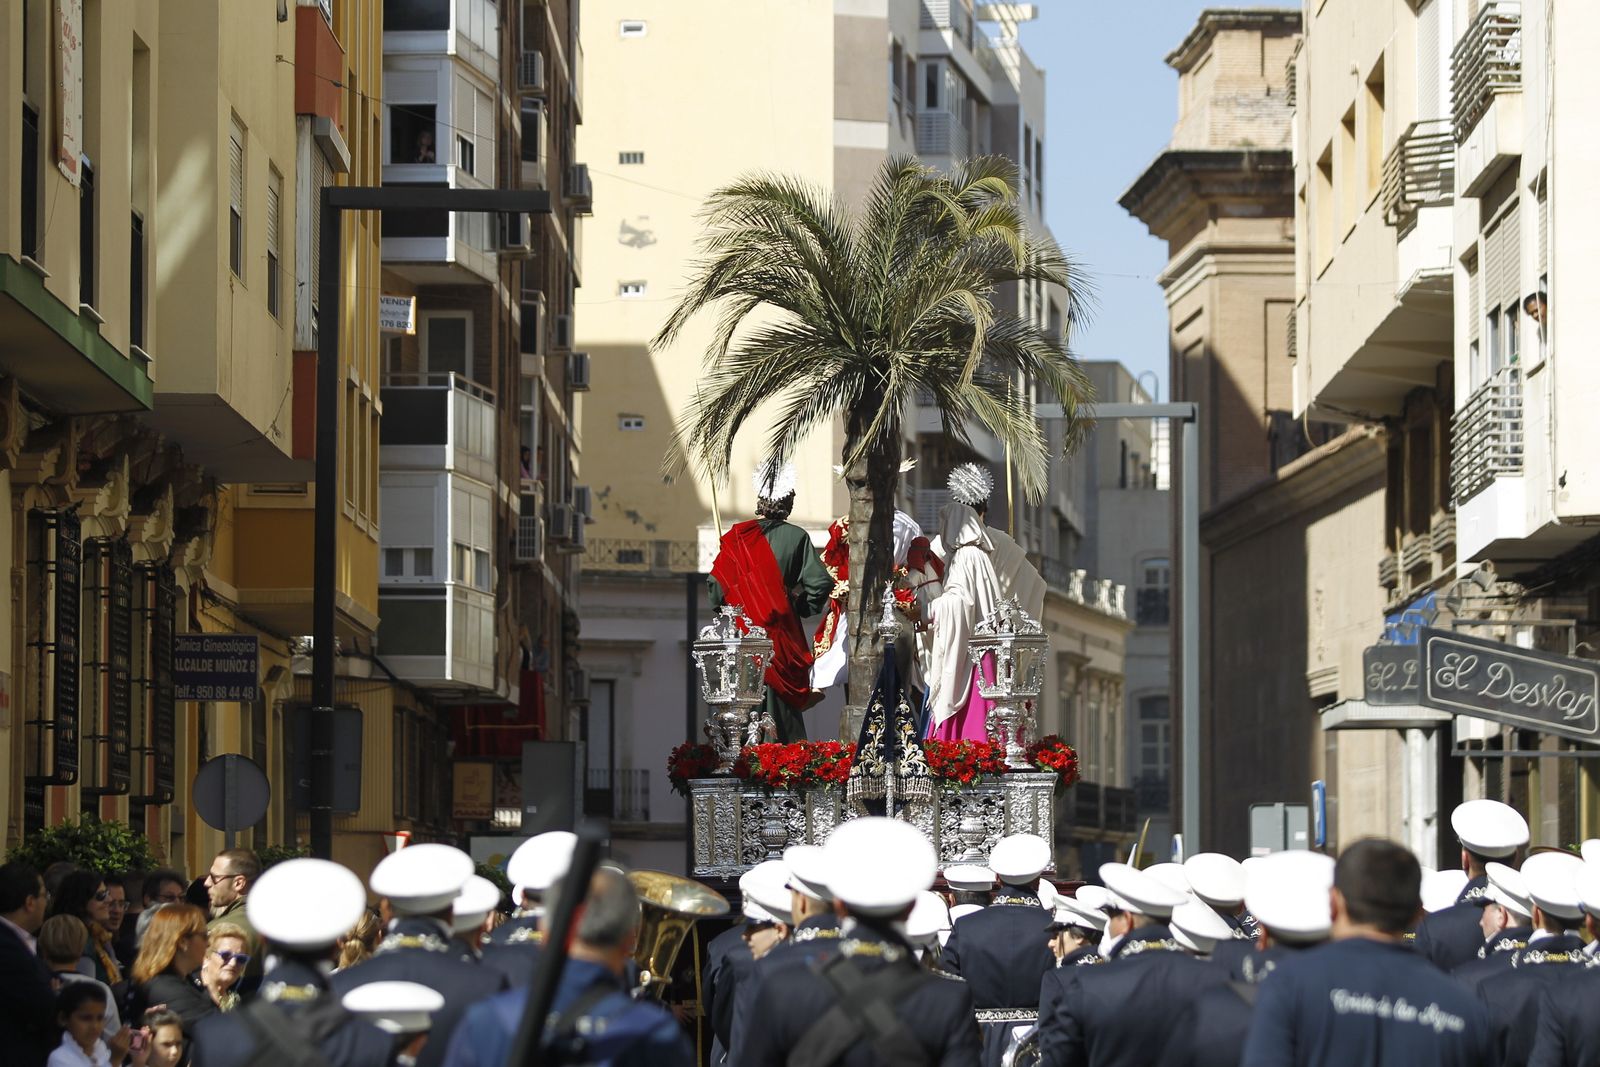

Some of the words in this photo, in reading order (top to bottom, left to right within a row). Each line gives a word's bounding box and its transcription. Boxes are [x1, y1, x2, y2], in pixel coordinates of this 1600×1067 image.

[380, 297, 412, 306] VENDE
[215, 656, 248, 673] MUÑOZ
[1435, 653, 1479, 690] El
[196, 685, 213, 699] 950
[215, 686, 227, 699] 88
[228, 686, 241, 699] 44
[242, 686, 254, 700] 48
